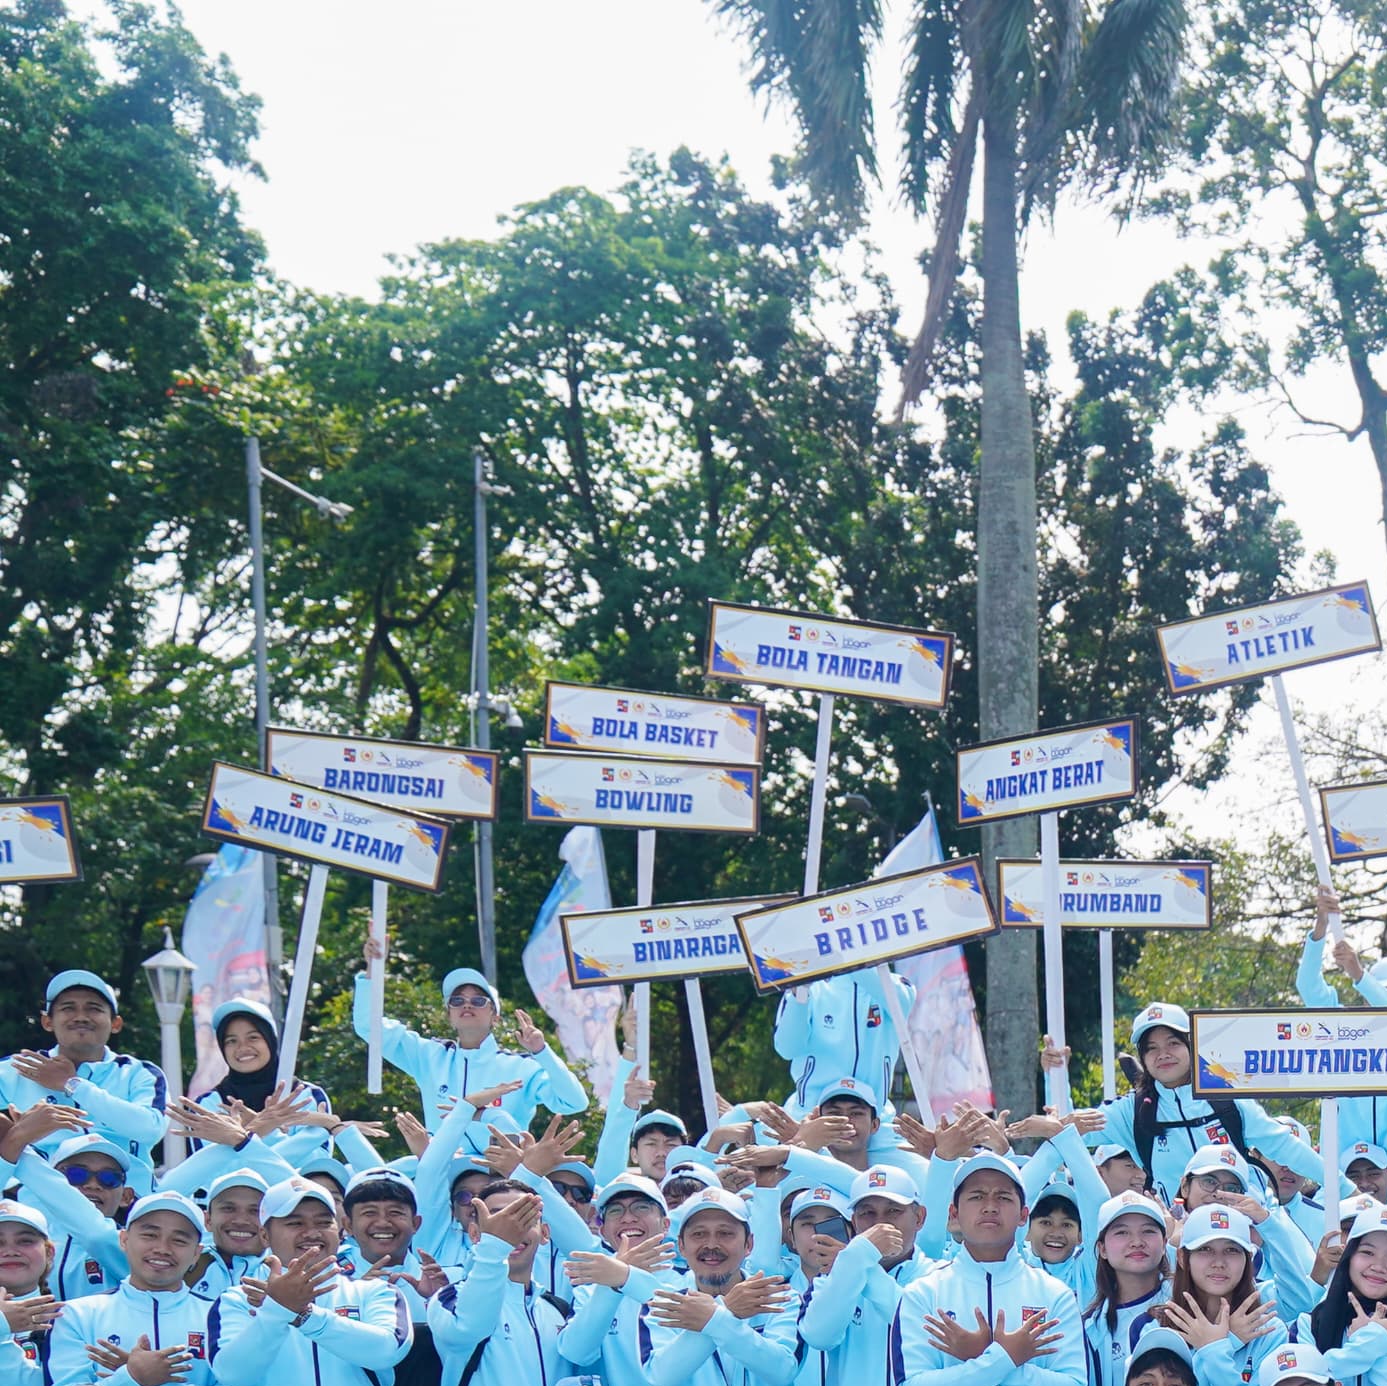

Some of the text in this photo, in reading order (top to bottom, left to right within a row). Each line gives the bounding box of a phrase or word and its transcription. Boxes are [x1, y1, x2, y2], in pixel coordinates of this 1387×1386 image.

[1227, 626, 1316, 664] ATLETIK
[757, 644, 903, 683] BOLA TANGAN
[591, 717, 718, 749] BOLA BASKET
[324, 768, 444, 798] BARONGSAI
[986, 760, 1104, 802] ANGKAT BERAT
[595, 789, 693, 813] BOWLING
[250, 806, 404, 864] ARUNG JERAM
[1059, 893, 1161, 913] RUMBAND
[633, 934, 741, 963] BINARAGA
[814, 908, 929, 956] BRIDGE
